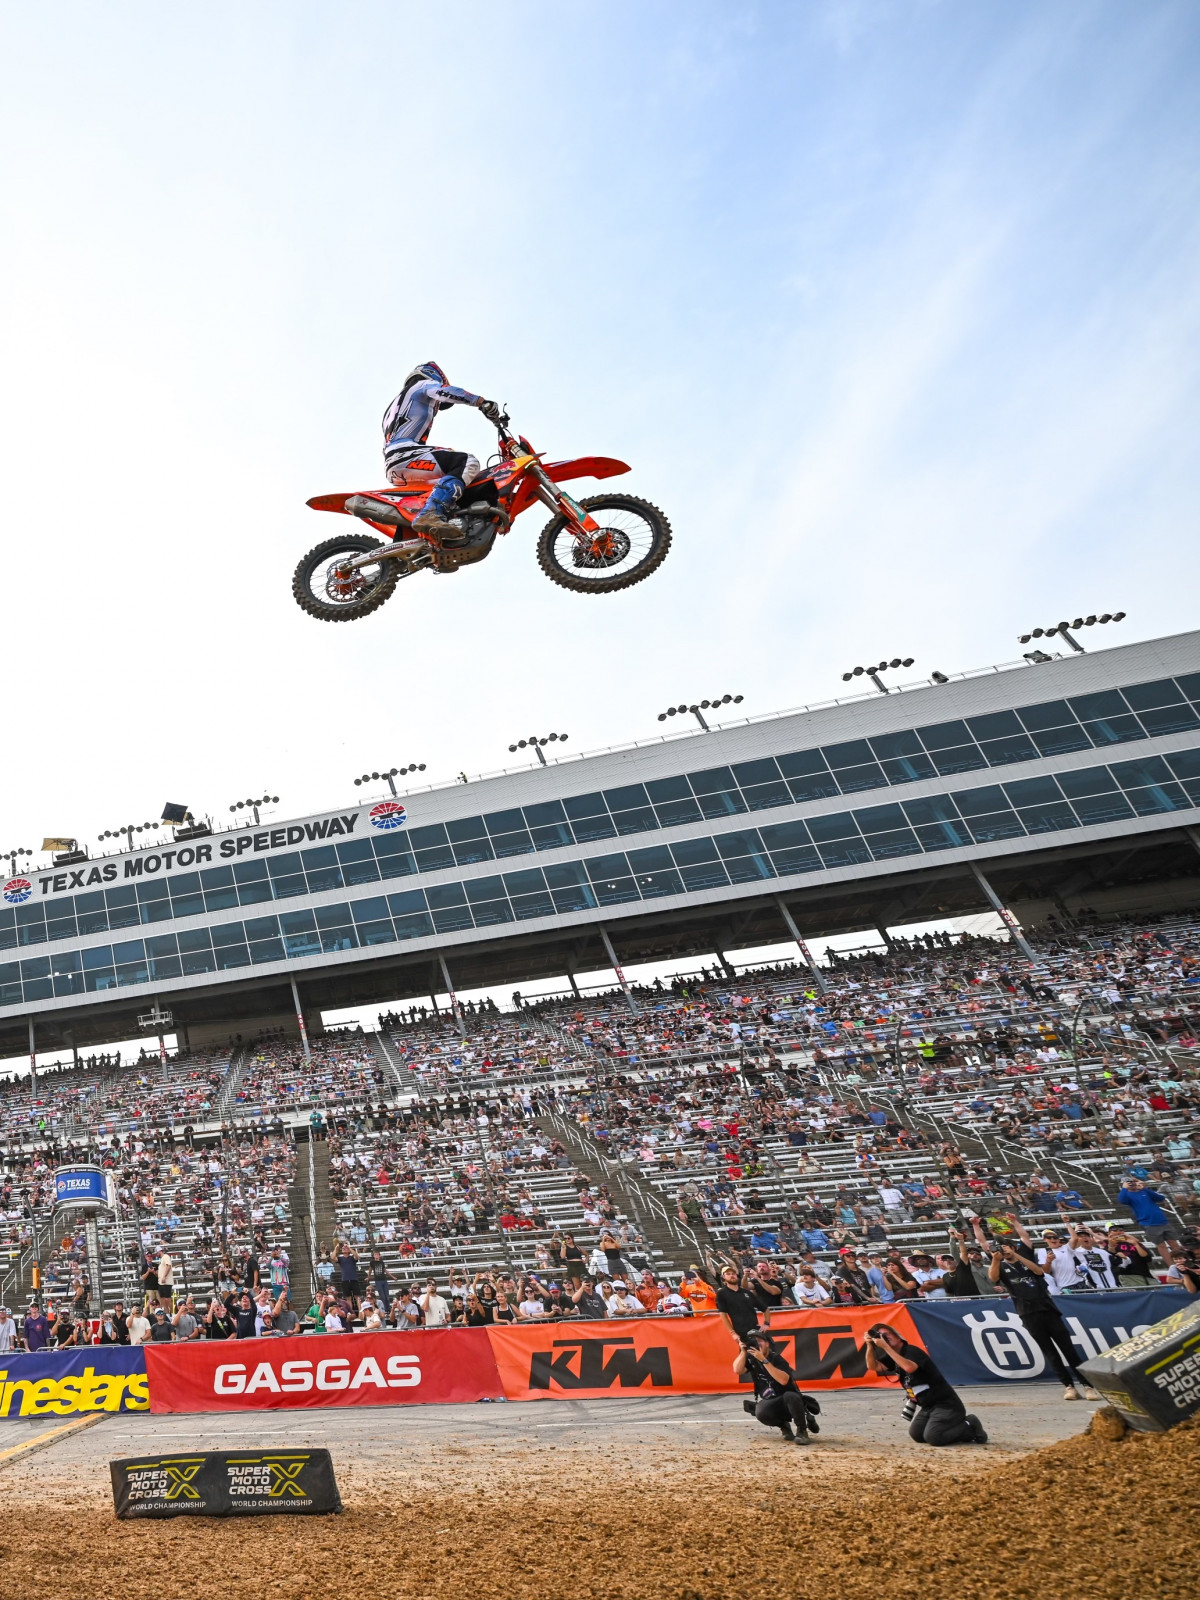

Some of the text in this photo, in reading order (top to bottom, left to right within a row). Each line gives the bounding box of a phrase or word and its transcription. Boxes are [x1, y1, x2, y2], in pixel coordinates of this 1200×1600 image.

[406, 459, 437, 472] KTM
[38, 813, 360, 895] TEXAS MOTOR SPEEDWAY
[67, 1178, 90, 1187] TEXAS
[528, 1337, 673, 1390] KTM
[213, 1355, 422, 1395] GASGAS
[127, 1470, 168, 1482] SUPER
[227, 1466, 271, 1476] SUPER
[130, 1480, 167, 1491] MOTO
[231, 1476, 270, 1485] MOTO
[128, 1489, 168, 1500] CROSS
[229, 1485, 271, 1495] CROSS
[153, 1501, 206, 1510] CHAMPIONSHIP
[258, 1499, 313, 1507] CHAMPIONSHIP
